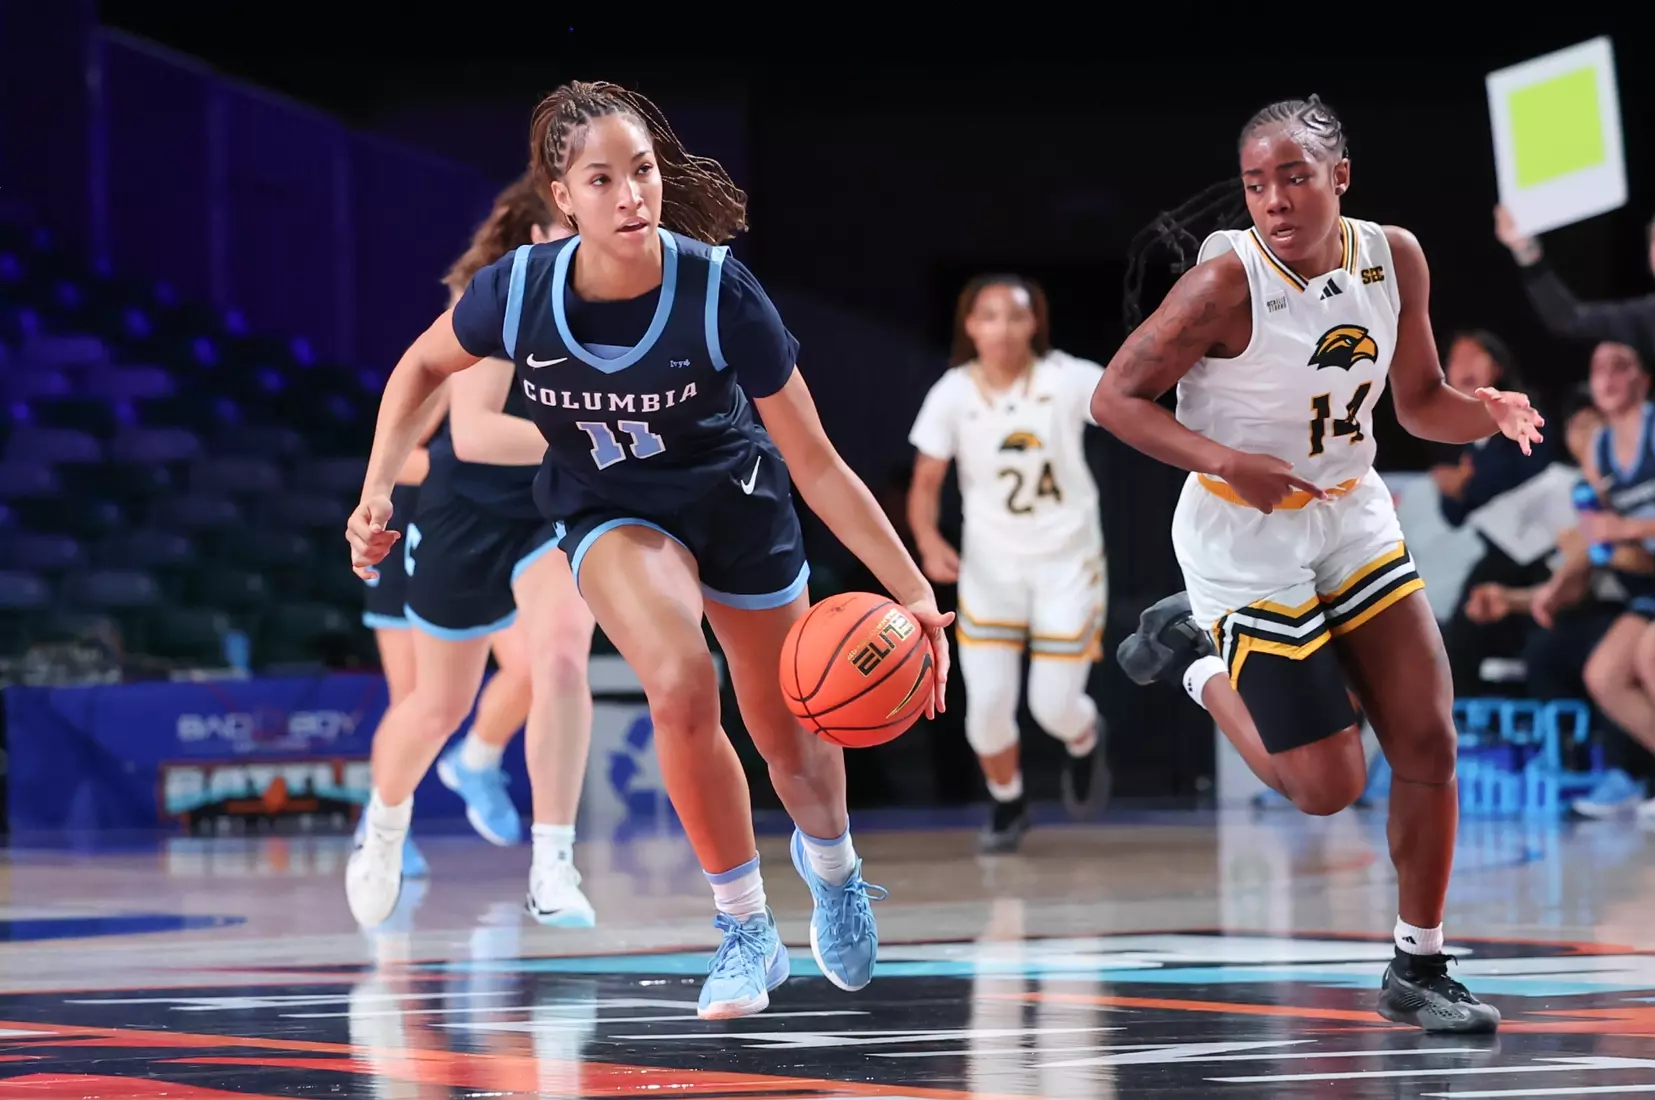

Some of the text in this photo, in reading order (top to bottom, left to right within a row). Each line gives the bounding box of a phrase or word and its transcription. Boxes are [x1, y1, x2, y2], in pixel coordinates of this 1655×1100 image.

[523, 379, 698, 413] COLUMBIA
[1308, 381, 1372, 458] 14
[575, 420, 667, 471] 11
[998, 460, 1063, 515] 24
[850, 612, 916, 678] ELITE
